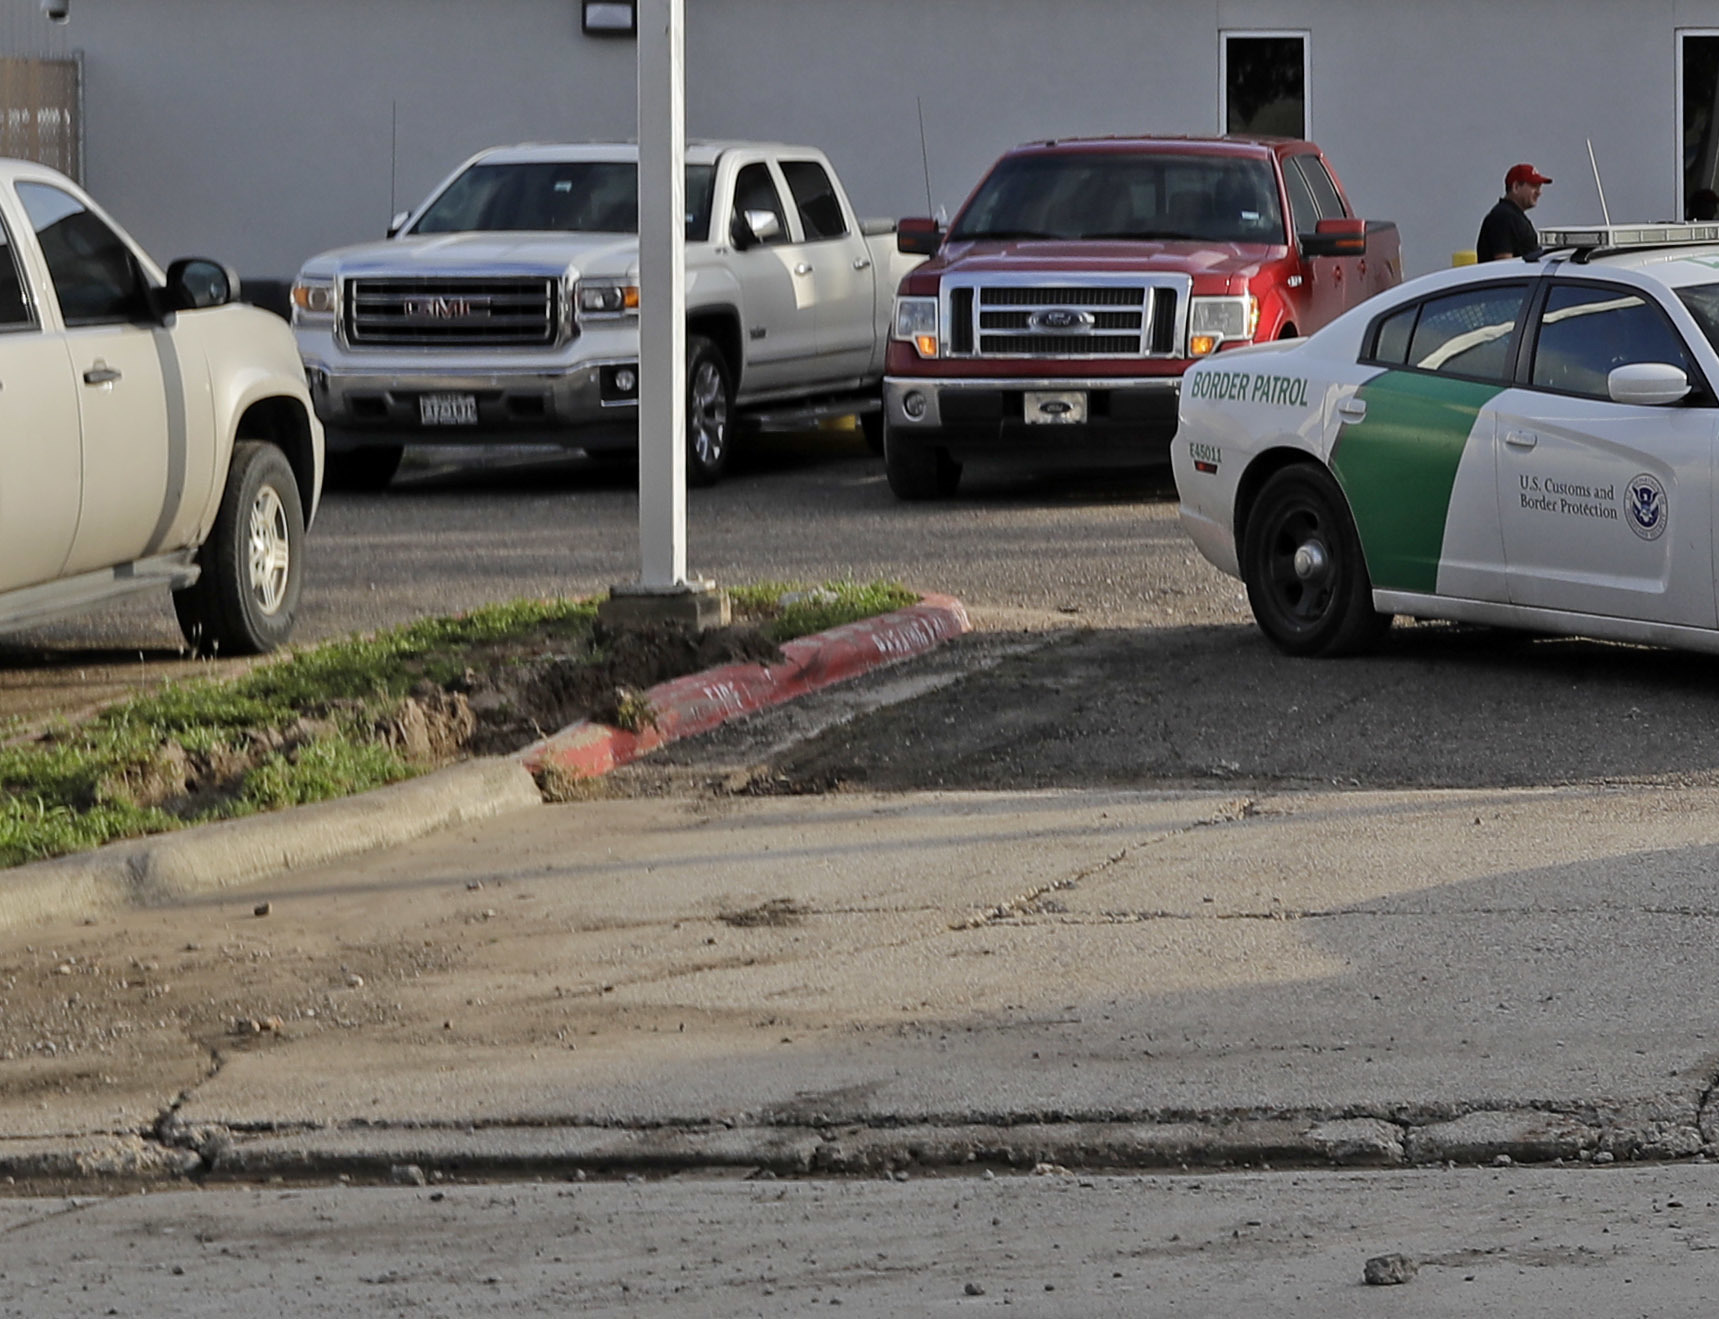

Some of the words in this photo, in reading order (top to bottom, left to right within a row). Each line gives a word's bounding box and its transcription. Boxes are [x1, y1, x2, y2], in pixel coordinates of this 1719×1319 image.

[1191, 371, 1250, 400] BORDER
[1251, 375, 1308, 407] PATROL
[1189, 442, 1222, 463] E45011
[1519, 475, 1541, 491] U.S.
[1544, 477, 1591, 497] Customs
[1594, 484, 1614, 500] and
[1520, 493, 1556, 511] Border
[1560, 497, 1618, 519] Protection
